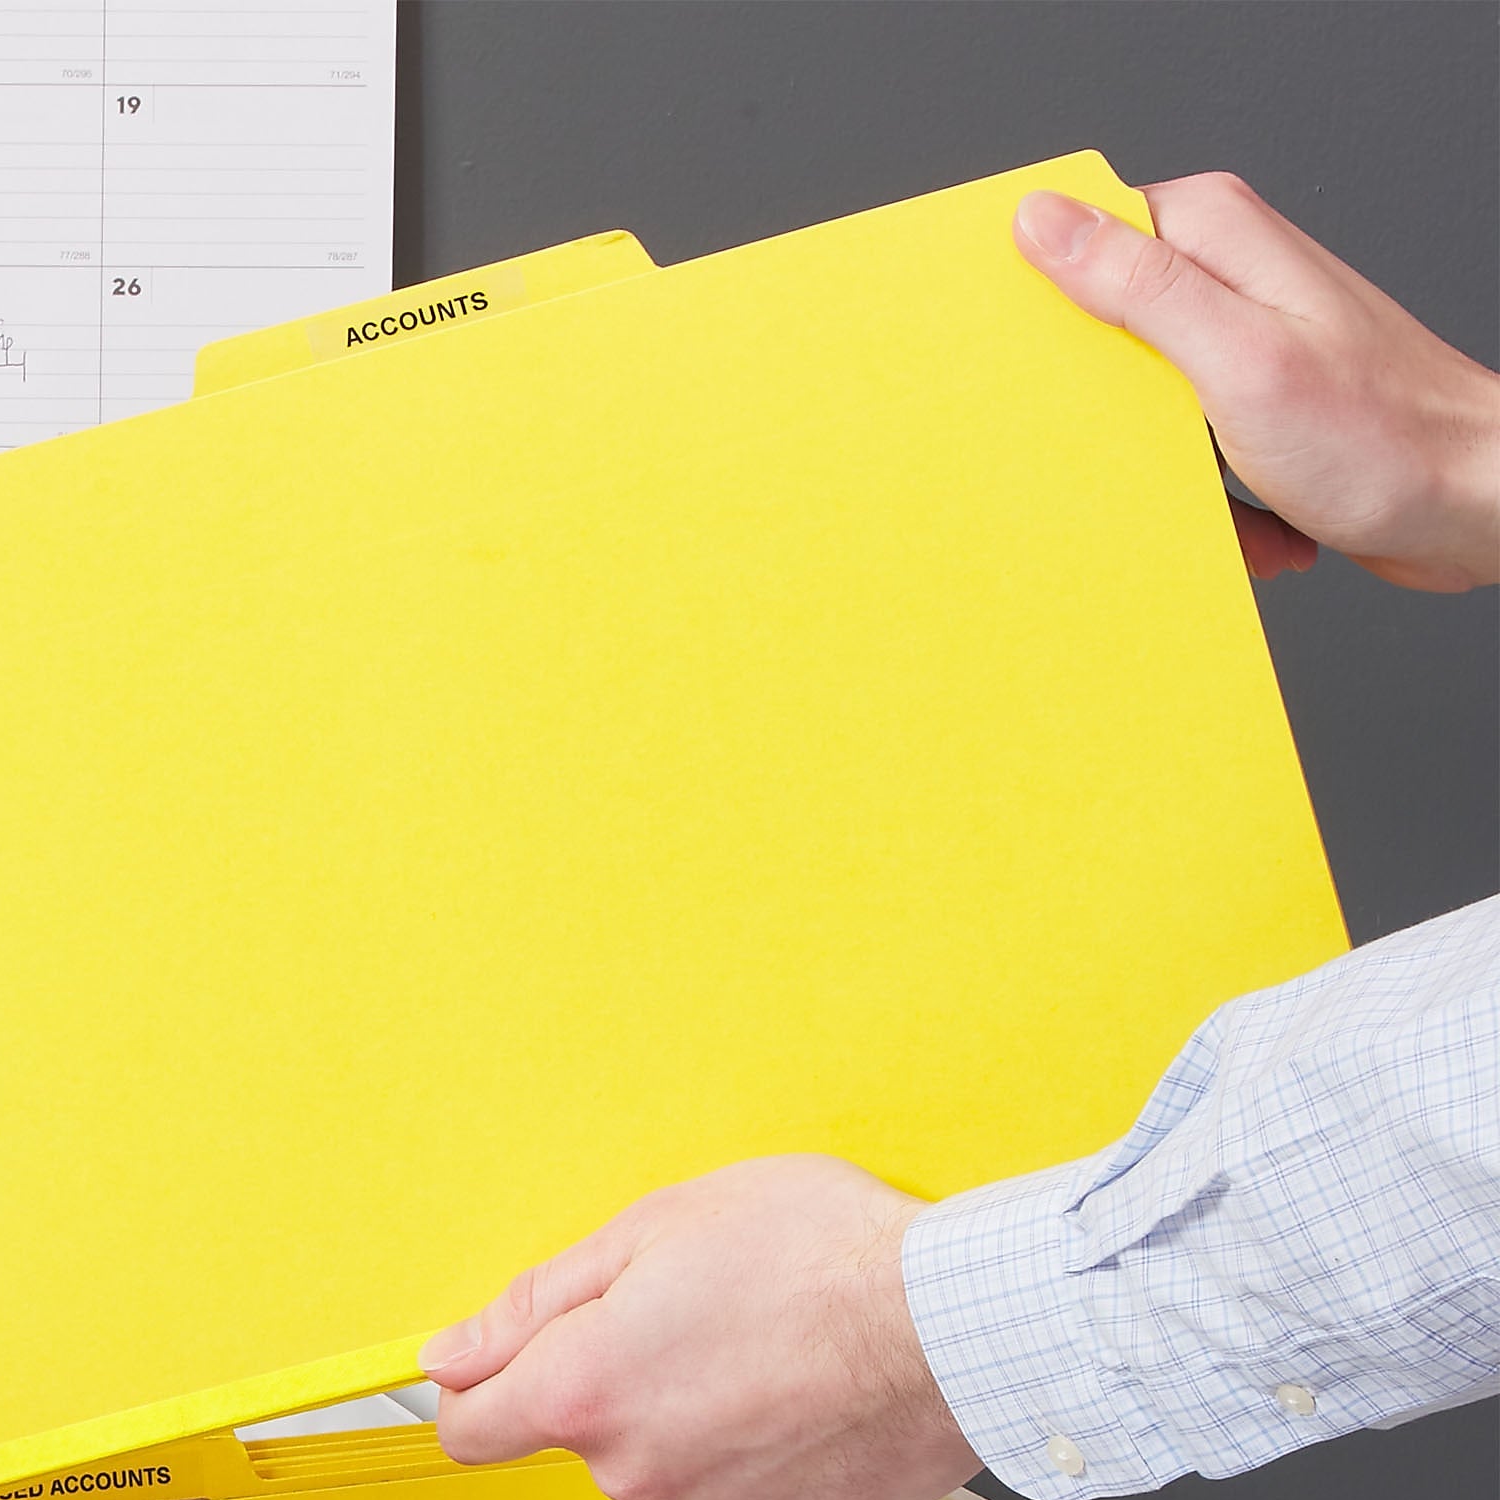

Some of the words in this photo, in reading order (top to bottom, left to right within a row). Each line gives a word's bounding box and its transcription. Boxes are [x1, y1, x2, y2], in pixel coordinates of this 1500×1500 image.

[116, 95, 142, 115] 19
[112, 277, 142, 296] 26
[346, 291, 489, 348] ACCOUNTS
[50, 1466, 172, 1497] ACCOUNTS
